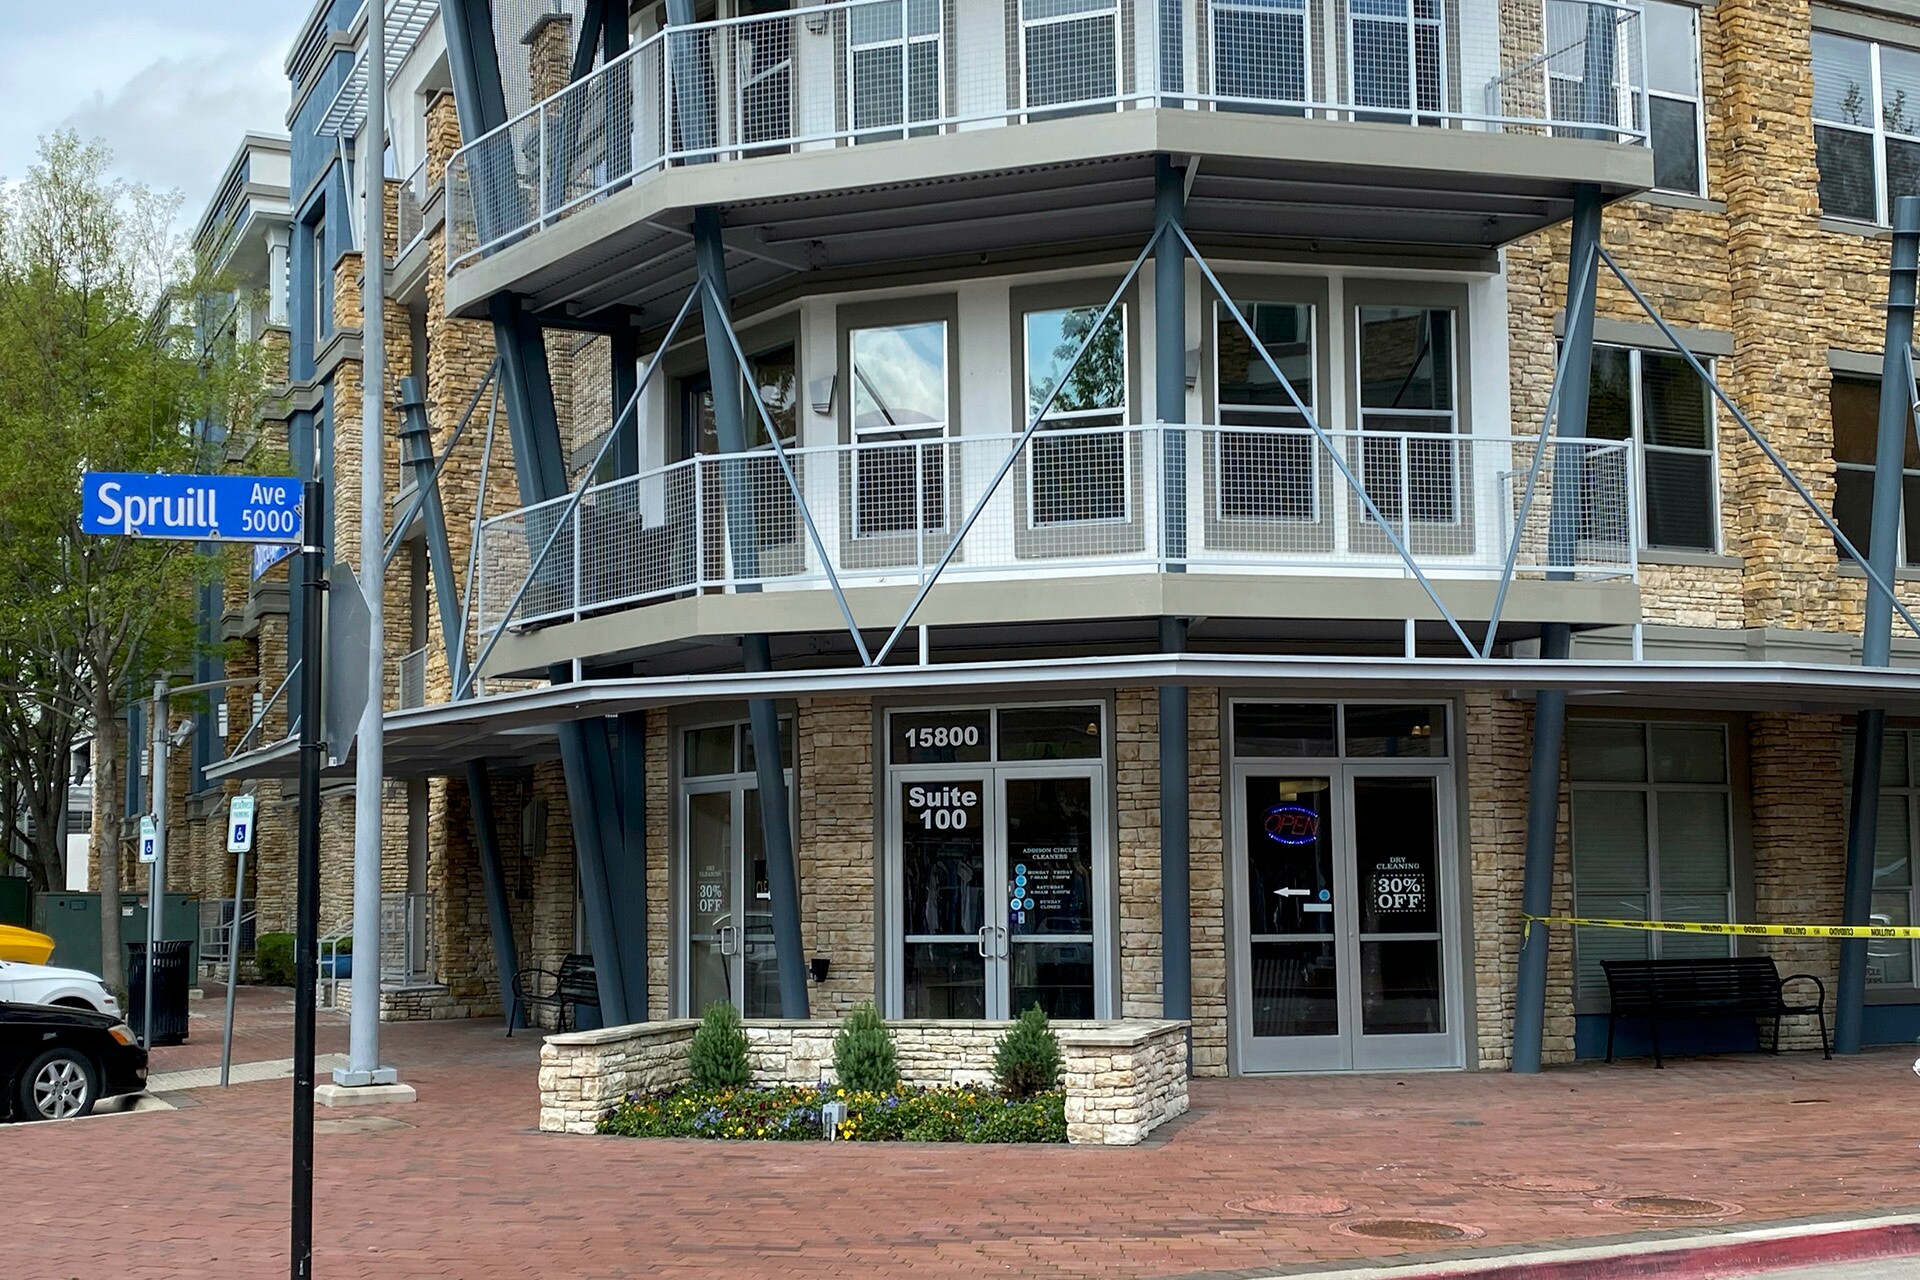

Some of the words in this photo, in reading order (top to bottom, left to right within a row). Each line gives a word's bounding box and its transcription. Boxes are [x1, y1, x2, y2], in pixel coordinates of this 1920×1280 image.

[250, 483, 286, 505] Ave
[97, 481, 219, 535] Spruill
[241, 509, 294, 533] 5000
[904, 725, 978, 748] 15800
[908, 786, 977, 808] Suite
[919, 808, 967, 830] 100
[1264, 813, 1320, 836] OPEN
[699, 884, 723, 898] 30%
[1378, 878, 1421, 893] 30%
[699, 898, 723, 912] OFF
[1378, 894, 1422, 909] OFF
[1783, 927, 1807, 935] CAUTION
[1870, 928, 1896, 937] CAUTION
